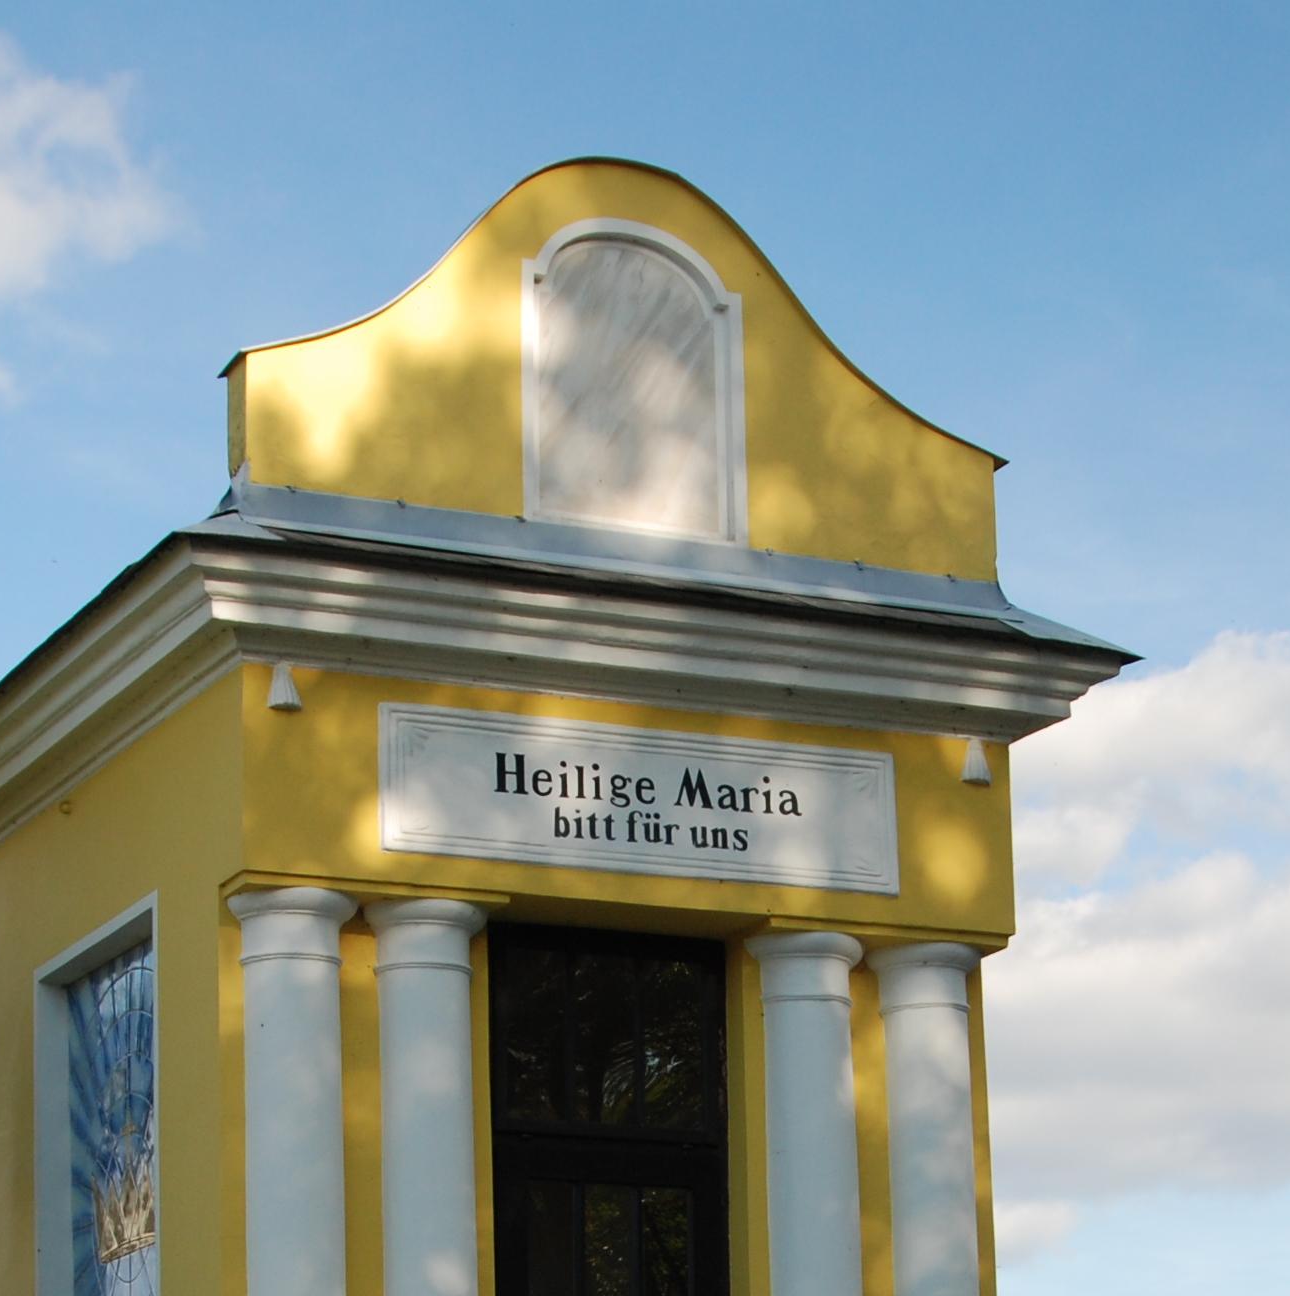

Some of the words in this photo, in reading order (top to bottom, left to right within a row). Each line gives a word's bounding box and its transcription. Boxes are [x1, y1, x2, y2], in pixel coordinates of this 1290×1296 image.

[494, 752, 656, 808] Heilige
[674, 767, 803, 817] Maria
[554, 807, 616, 841] bitt
[626, 810, 680, 845] für
[690, 826, 749, 852] uns
